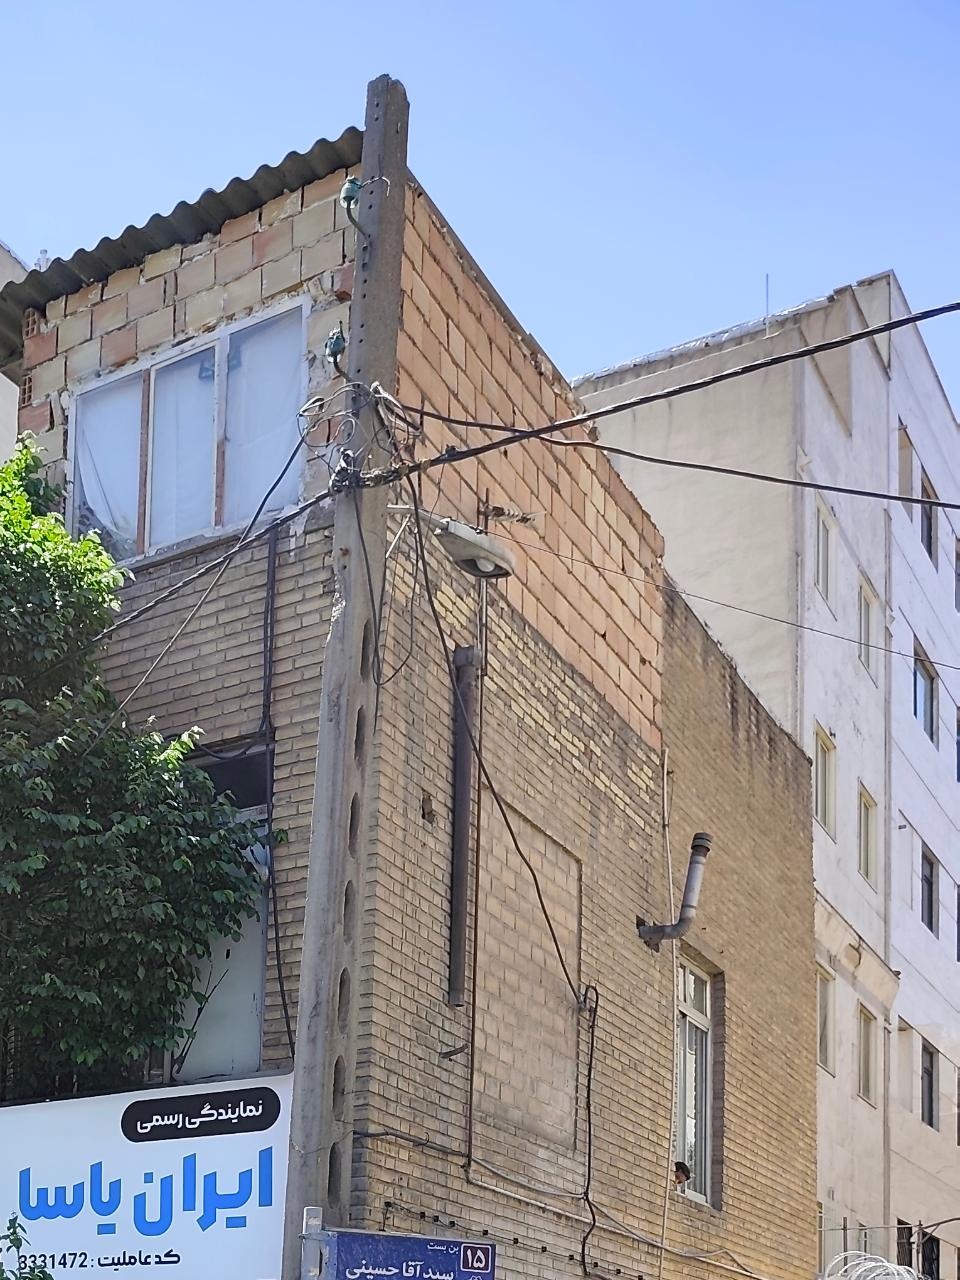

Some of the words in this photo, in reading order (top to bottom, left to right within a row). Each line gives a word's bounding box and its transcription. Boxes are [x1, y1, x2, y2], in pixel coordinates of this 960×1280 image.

[136, 1114, 183, 1134] رسمی
[185, 1100, 263, 1129] نمایندگی
[18, 1160, 123, 1236] یاسا
[132, 1145, 273, 1237] ایران
[154, 1248, 181, 1265] کد
[427, 1242, 447, 1254] بست
[448, 1245, 459, 1254] بن
[466, 1248, 486, 1268] ۱۵
[345, 1259, 399, 1280] حسینی
[402, 1260, 424, 1278] آقا
